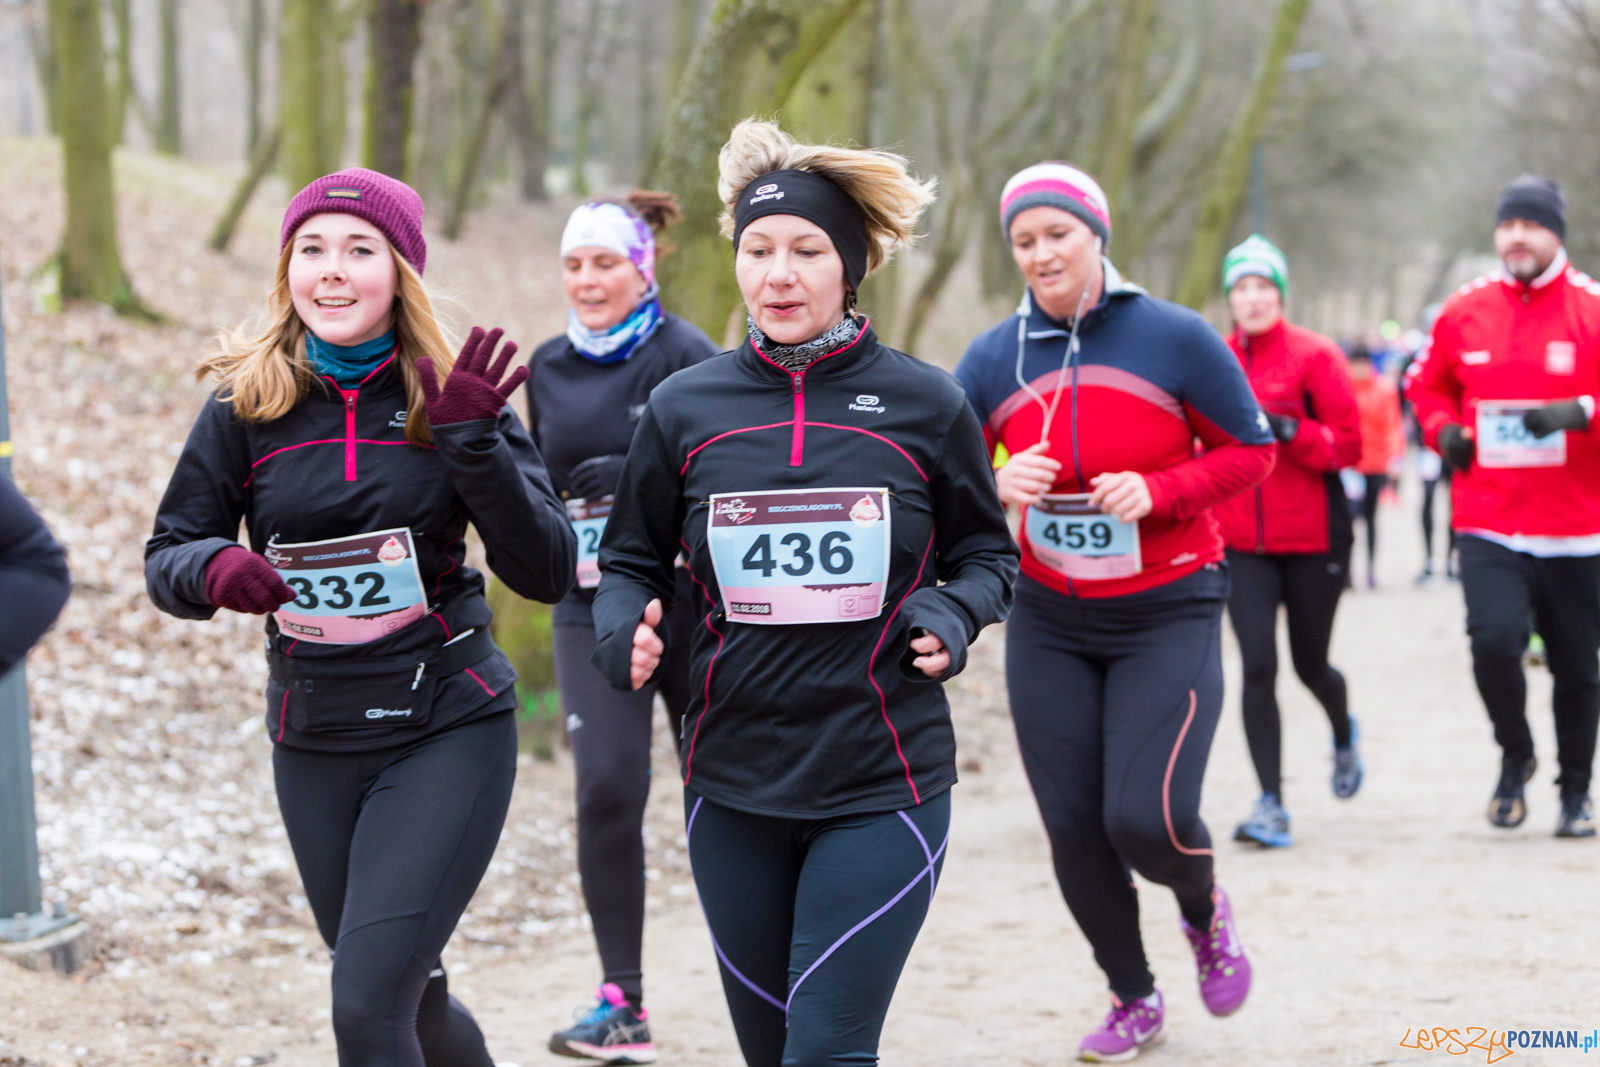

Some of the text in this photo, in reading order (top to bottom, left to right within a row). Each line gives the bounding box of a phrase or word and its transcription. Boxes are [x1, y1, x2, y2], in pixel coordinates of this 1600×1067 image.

[848, 403, 886, 414] Kalenji
[1042, 520, 1112, 549] 459
[741, 530, 855, 578] 436
[286, 571, 391, 610] 332
